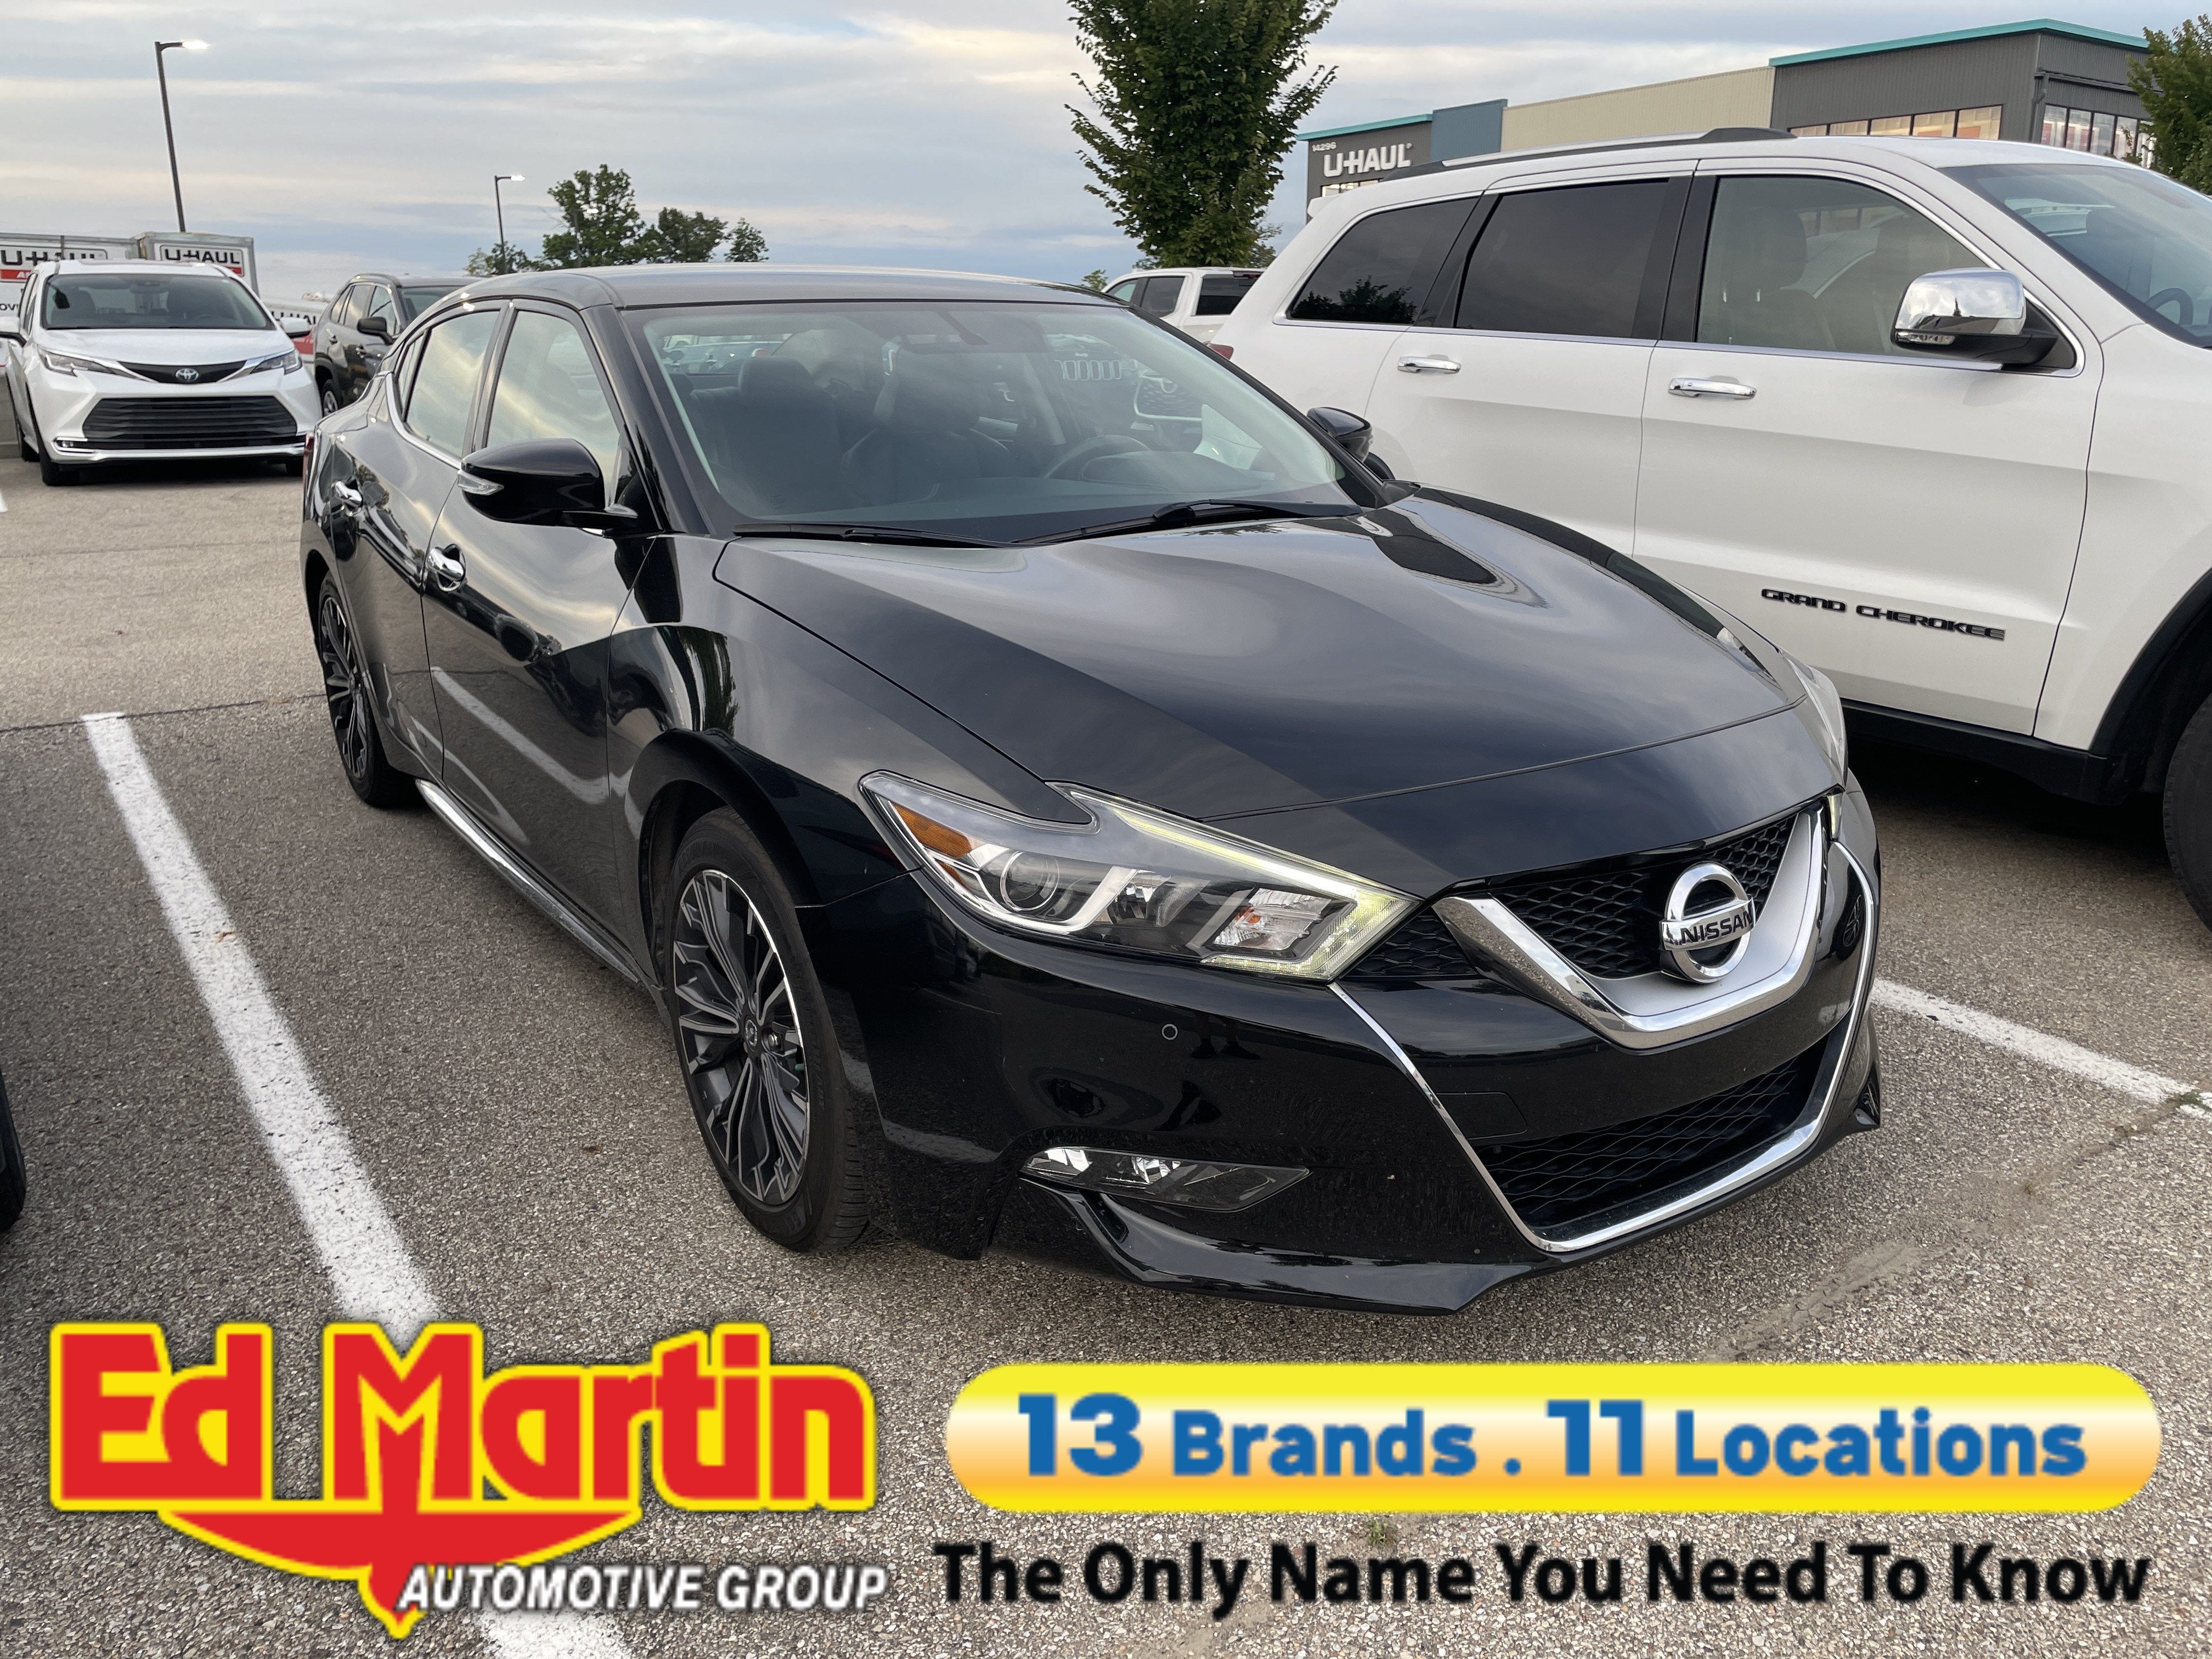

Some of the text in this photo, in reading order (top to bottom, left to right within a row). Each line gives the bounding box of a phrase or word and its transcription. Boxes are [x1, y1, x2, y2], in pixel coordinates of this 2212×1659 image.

[1761, 588, 2006, 641] GRAND CHEROKEE
[1680, 910, 1753, 944] NISSAN
